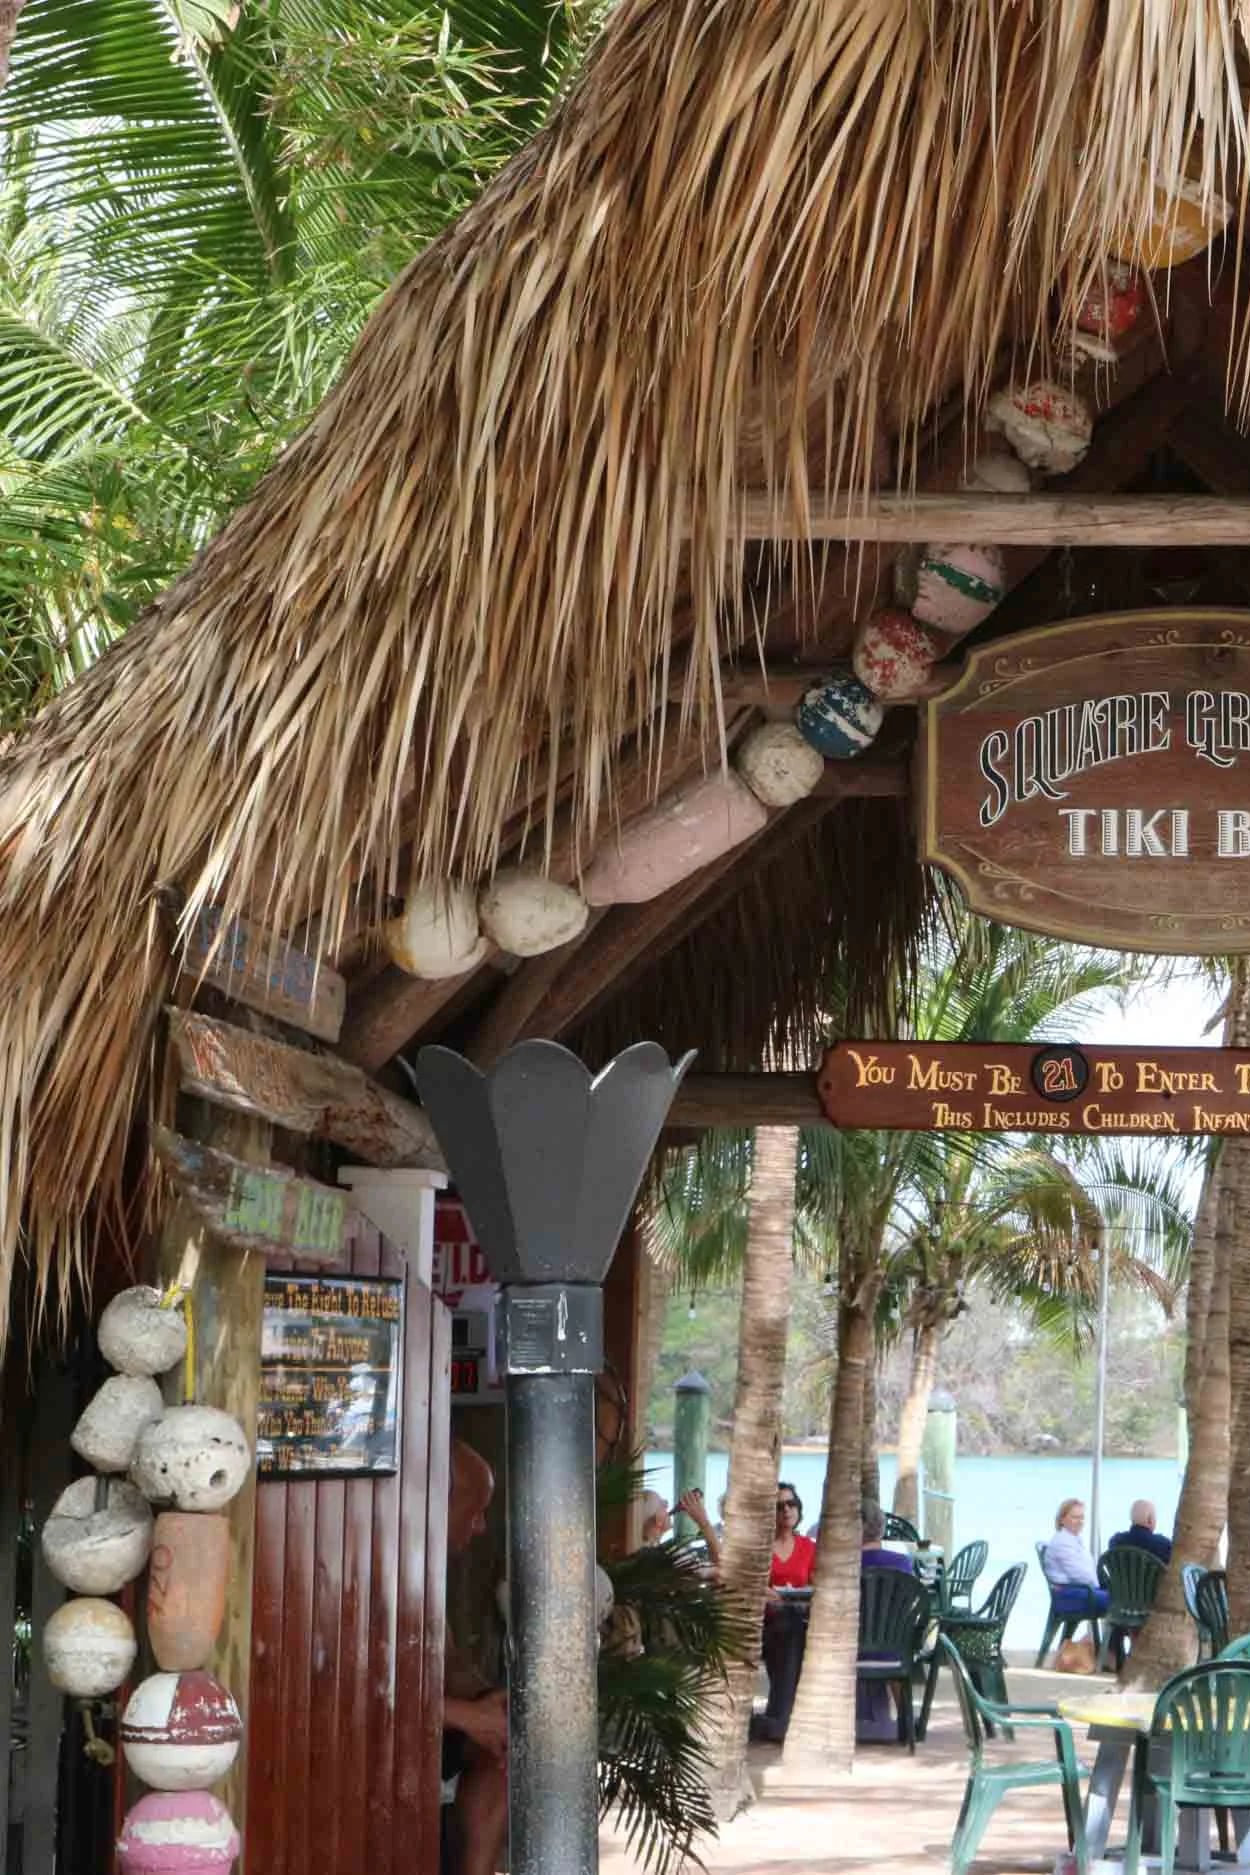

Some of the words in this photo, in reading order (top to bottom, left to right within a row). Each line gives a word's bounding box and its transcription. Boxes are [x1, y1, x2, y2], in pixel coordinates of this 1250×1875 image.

[979, 691, 1172, 828] SQUARE
[1058, 808, 1190, 858] TIKI
[1041, 1057, 1078, 1093] 21
